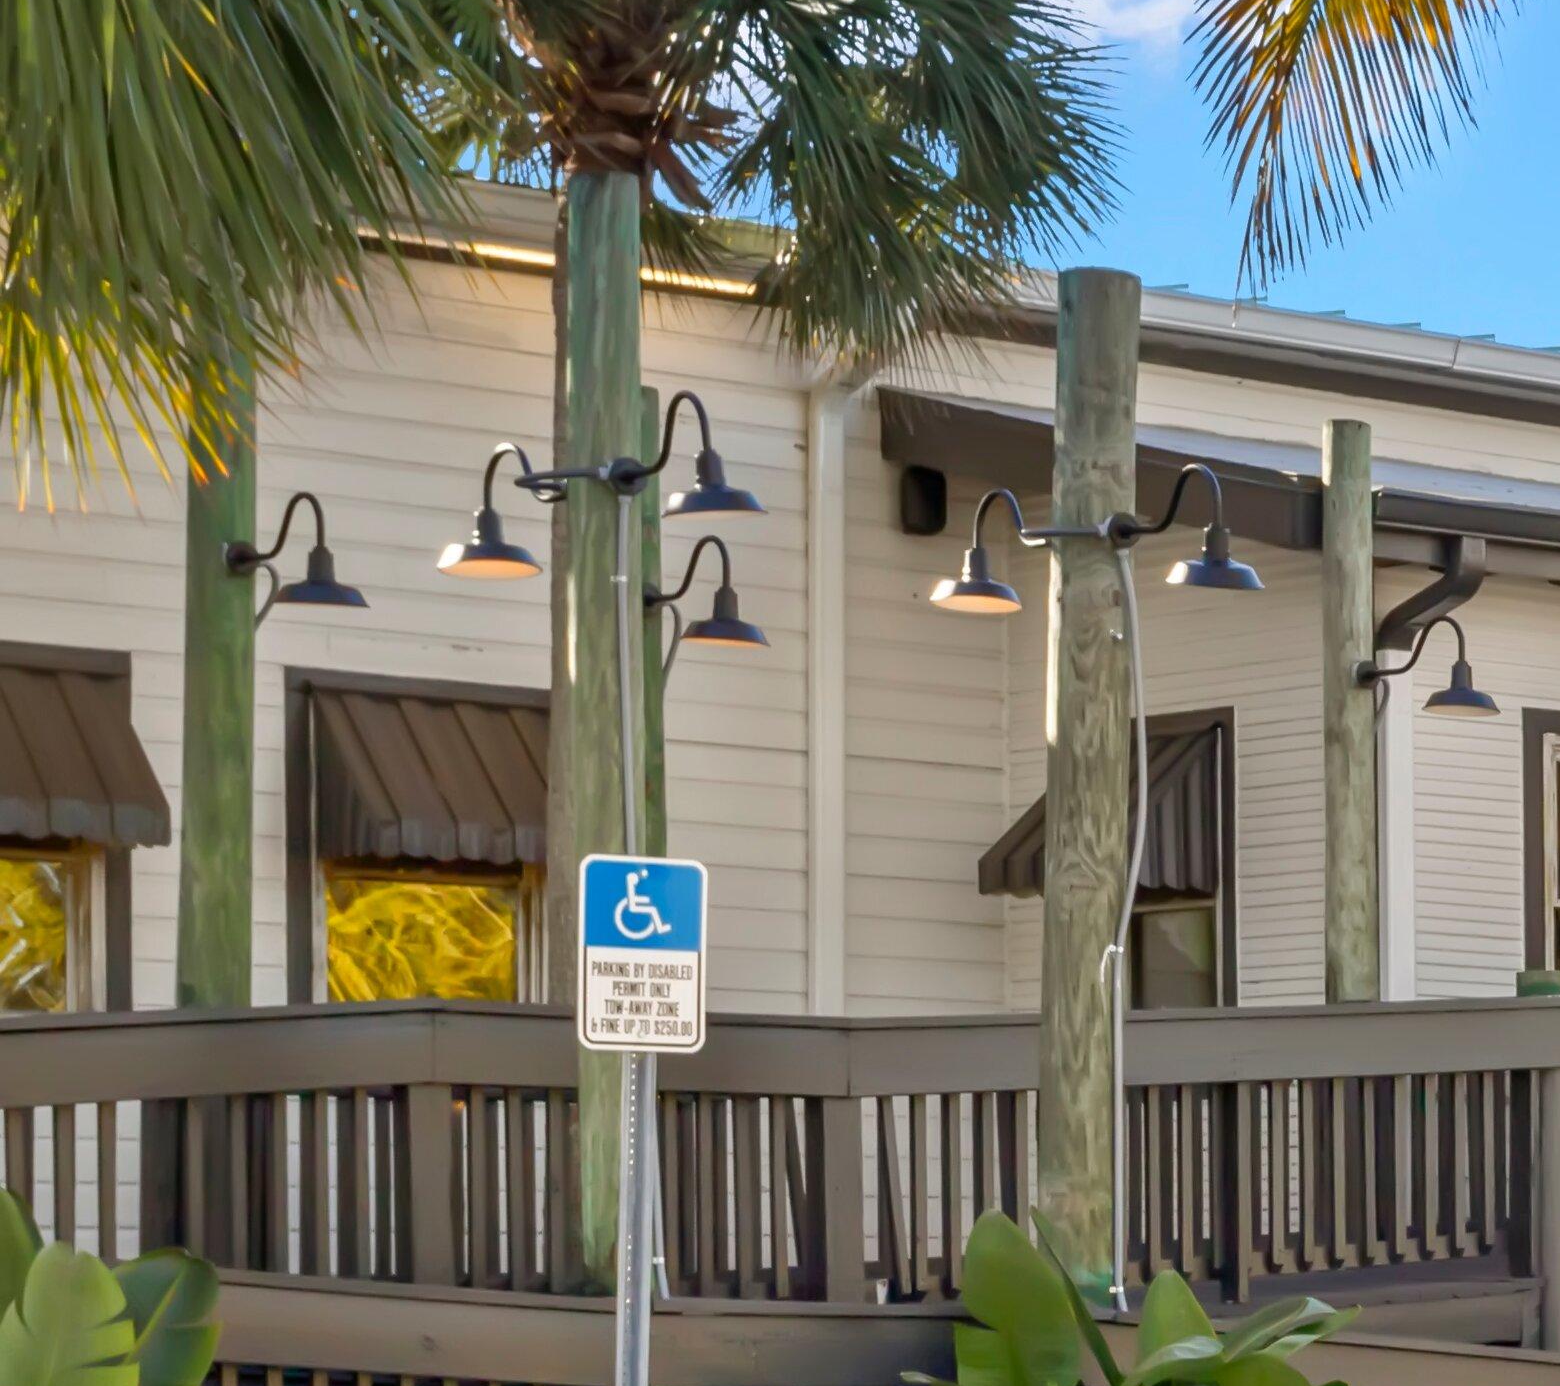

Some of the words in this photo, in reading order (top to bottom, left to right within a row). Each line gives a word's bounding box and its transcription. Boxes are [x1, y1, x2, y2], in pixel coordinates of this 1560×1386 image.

[592, 961, 630, 978] PARKING
[633, 962, 645, 979] BY
[648, 963, 693, 981] DISABLED
[612, 980, 646, 997] PERMIT
[650, 982, 671, 998] ONLY
[604, 999, 653, 1016] TOW-AWAY
[656, 1001, 679, 1017] ZONE
[601, 1018, 620, 1034] FINE
[624, 1019, 636, 1034] UP
[639, 1019, 651, 1035] TO
[654, 1019, 693, 1037] $250.00
